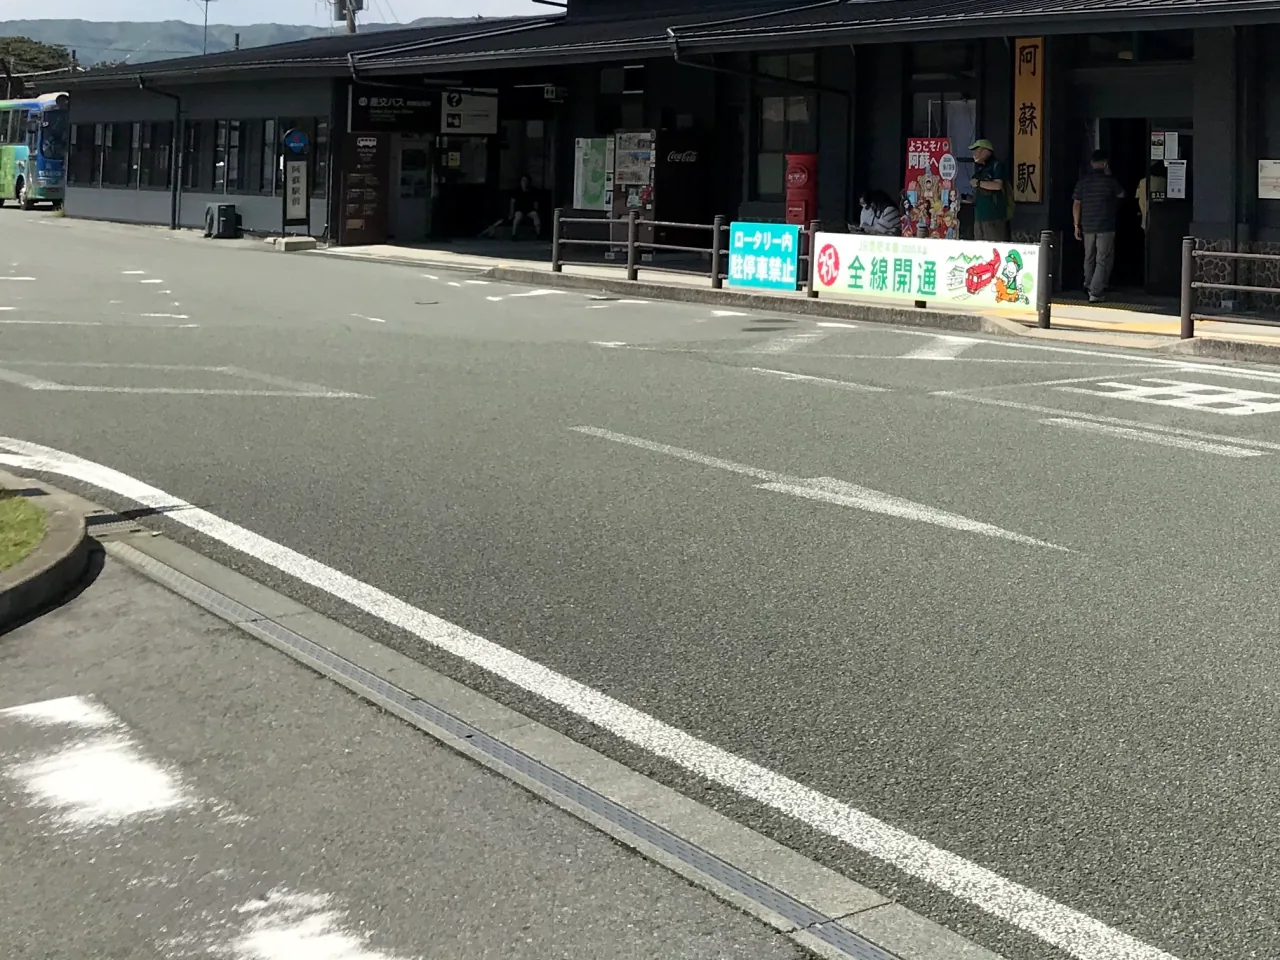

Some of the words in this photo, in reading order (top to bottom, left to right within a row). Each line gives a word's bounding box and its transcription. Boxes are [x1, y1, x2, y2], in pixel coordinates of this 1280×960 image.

[1016, 44, 1039, 194] 阿蘇駅
[734, 230, 793, 252] ロータリー内
[731, 254, 794, 283] 駐停車禁止
[818, 246, 839, 284] 祝
[847, 255, 936, 296] 全線開通
